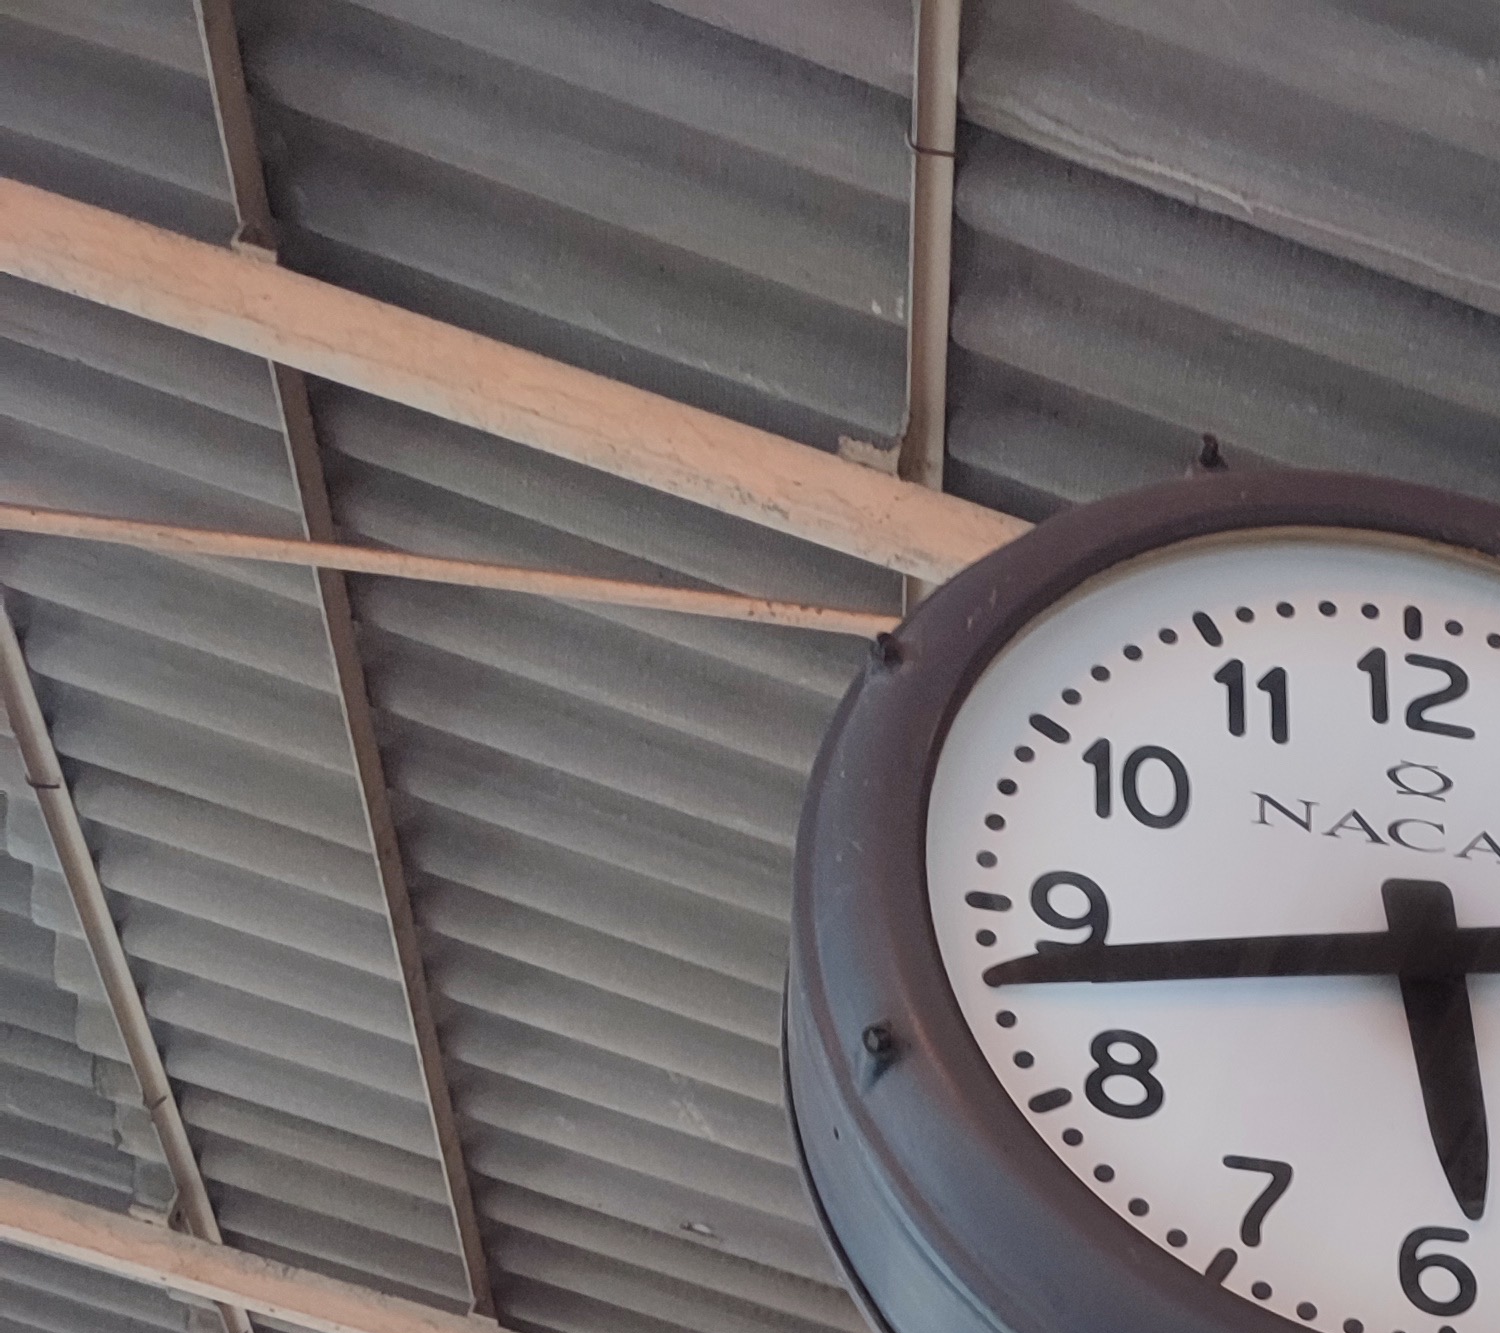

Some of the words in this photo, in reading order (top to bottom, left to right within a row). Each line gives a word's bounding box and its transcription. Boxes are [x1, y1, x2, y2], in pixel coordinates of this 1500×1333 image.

[1213, 658, 1289, 745] 11
[1356, 647, 1476, 740] 12
[1082, 737, 1190, 830] 10
[1029, 870, 1110, 952] 9
[1084, 1029, 1165, 1120] 8
[1222, 1154, 1294, 1248] 7
[1398, 1226, 1478, 1318] 6
